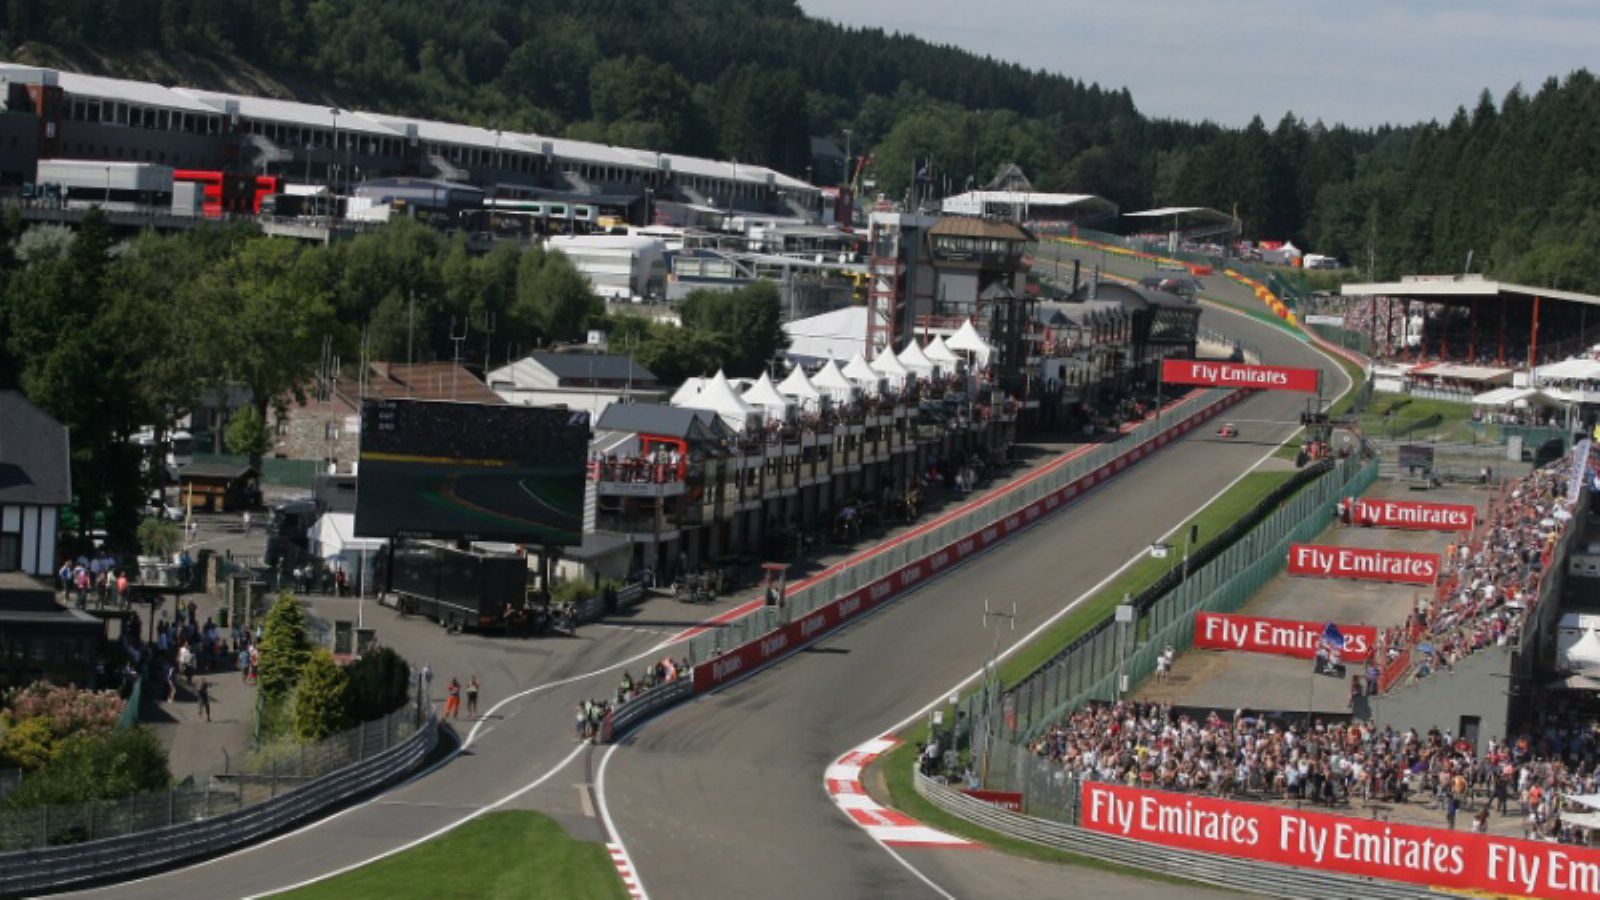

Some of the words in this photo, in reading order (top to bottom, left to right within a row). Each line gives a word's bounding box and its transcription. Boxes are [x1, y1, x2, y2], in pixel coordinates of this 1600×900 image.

[1192, 364, 1219, 382] Fly
[1220, 366, 1288, 385] Emirates
[1384, 503, 1469, 526] Emirates
[1297, 547, 1335, 574] Fly
[1338, 550, 1435, 577] Emirates
[1205, 616, 1249, 648] Fly
[1253, 620, 1368, 653] Emires
[1090, 787, 1136, 835] Fly
[1141, 796, 1258, 846] Emirates
[1279, 814, 1328, 864] Fly
[1334, 823, 1464, 875] Emirates
[1486, 842, 1541, 894] Fly
